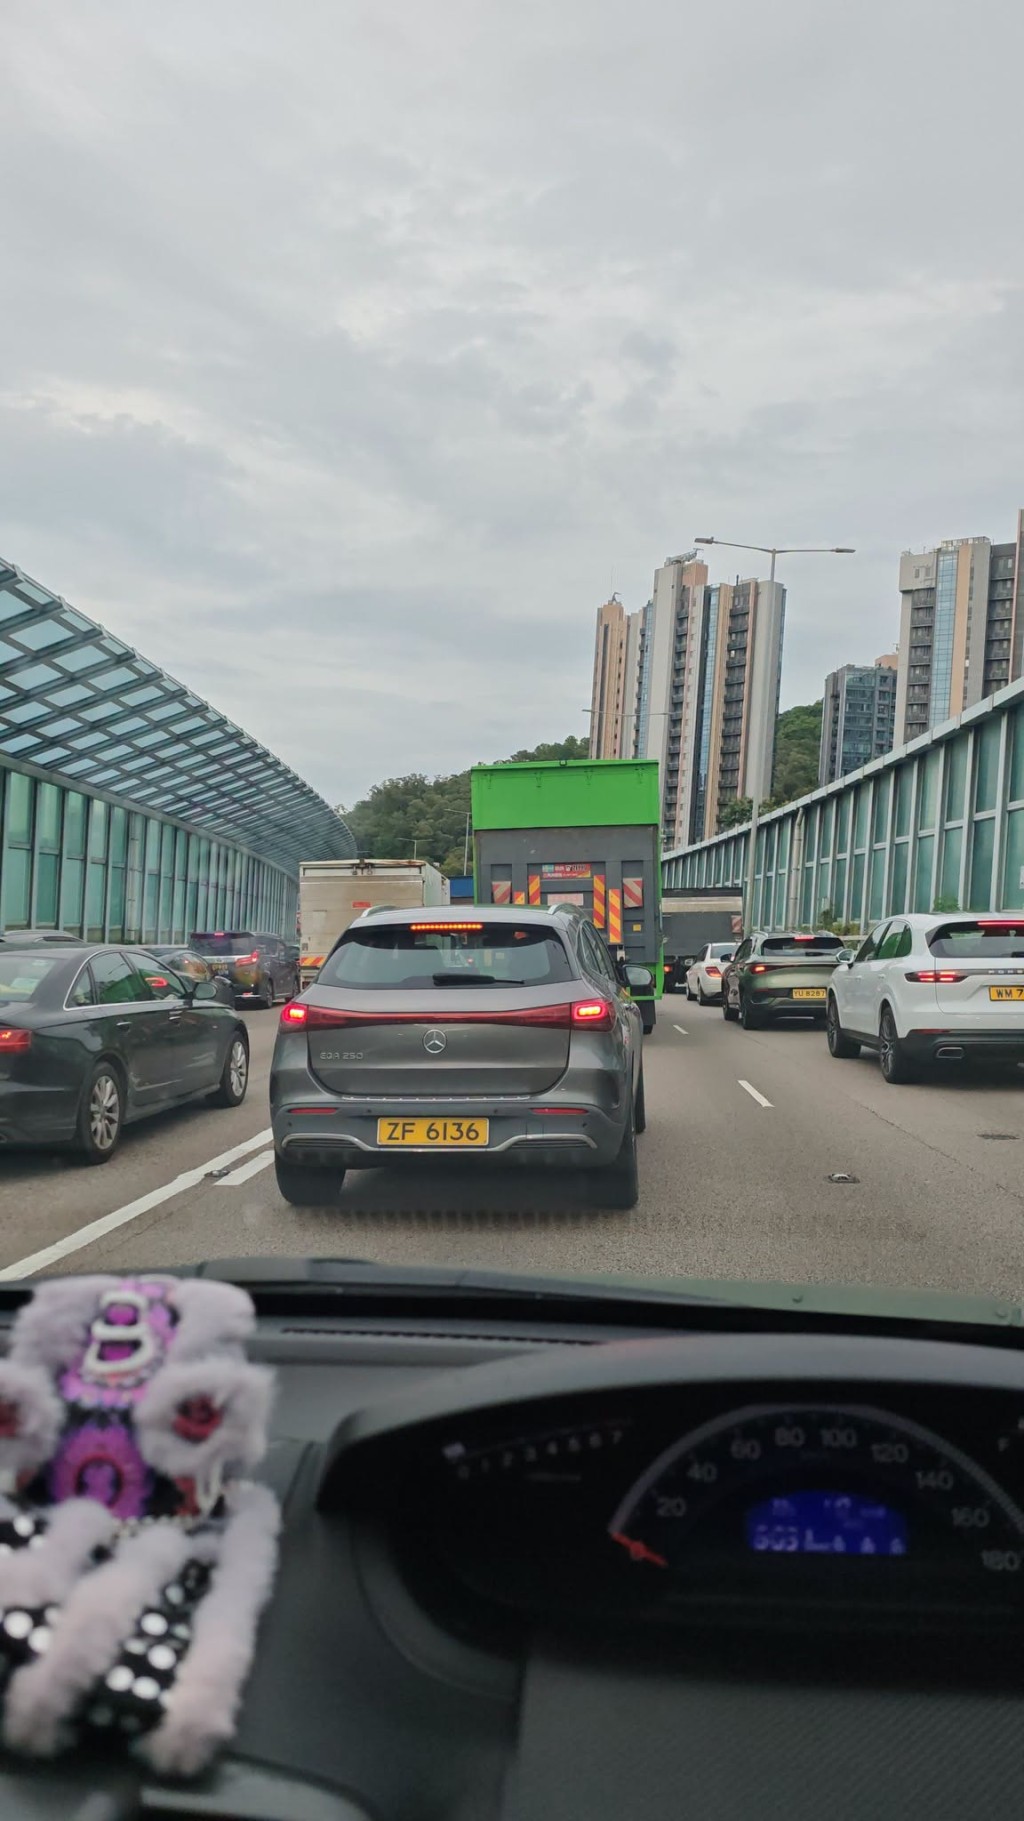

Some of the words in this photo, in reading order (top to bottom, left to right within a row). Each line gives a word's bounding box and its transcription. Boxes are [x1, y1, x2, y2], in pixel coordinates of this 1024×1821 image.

[995, 989, 1013, 998] WM
[320, 1052, 340, 1060] EQA
[342, 1052, 364, 1060] 250
[386, 1122, 416, 1141] ZF
[426, 1122, 479, 1141] 6136
[774, 1427, 804, 1448] 80
[820, 1427, 857, 1449] 100
[730, 1439, 761, 1460] 60
[871, 1443, 909, 1464] 120
[686, 1462, 717, 1483] 40
[916, 1469, 954, 1490] 140
[656, 1499, 686, 1517] 20
